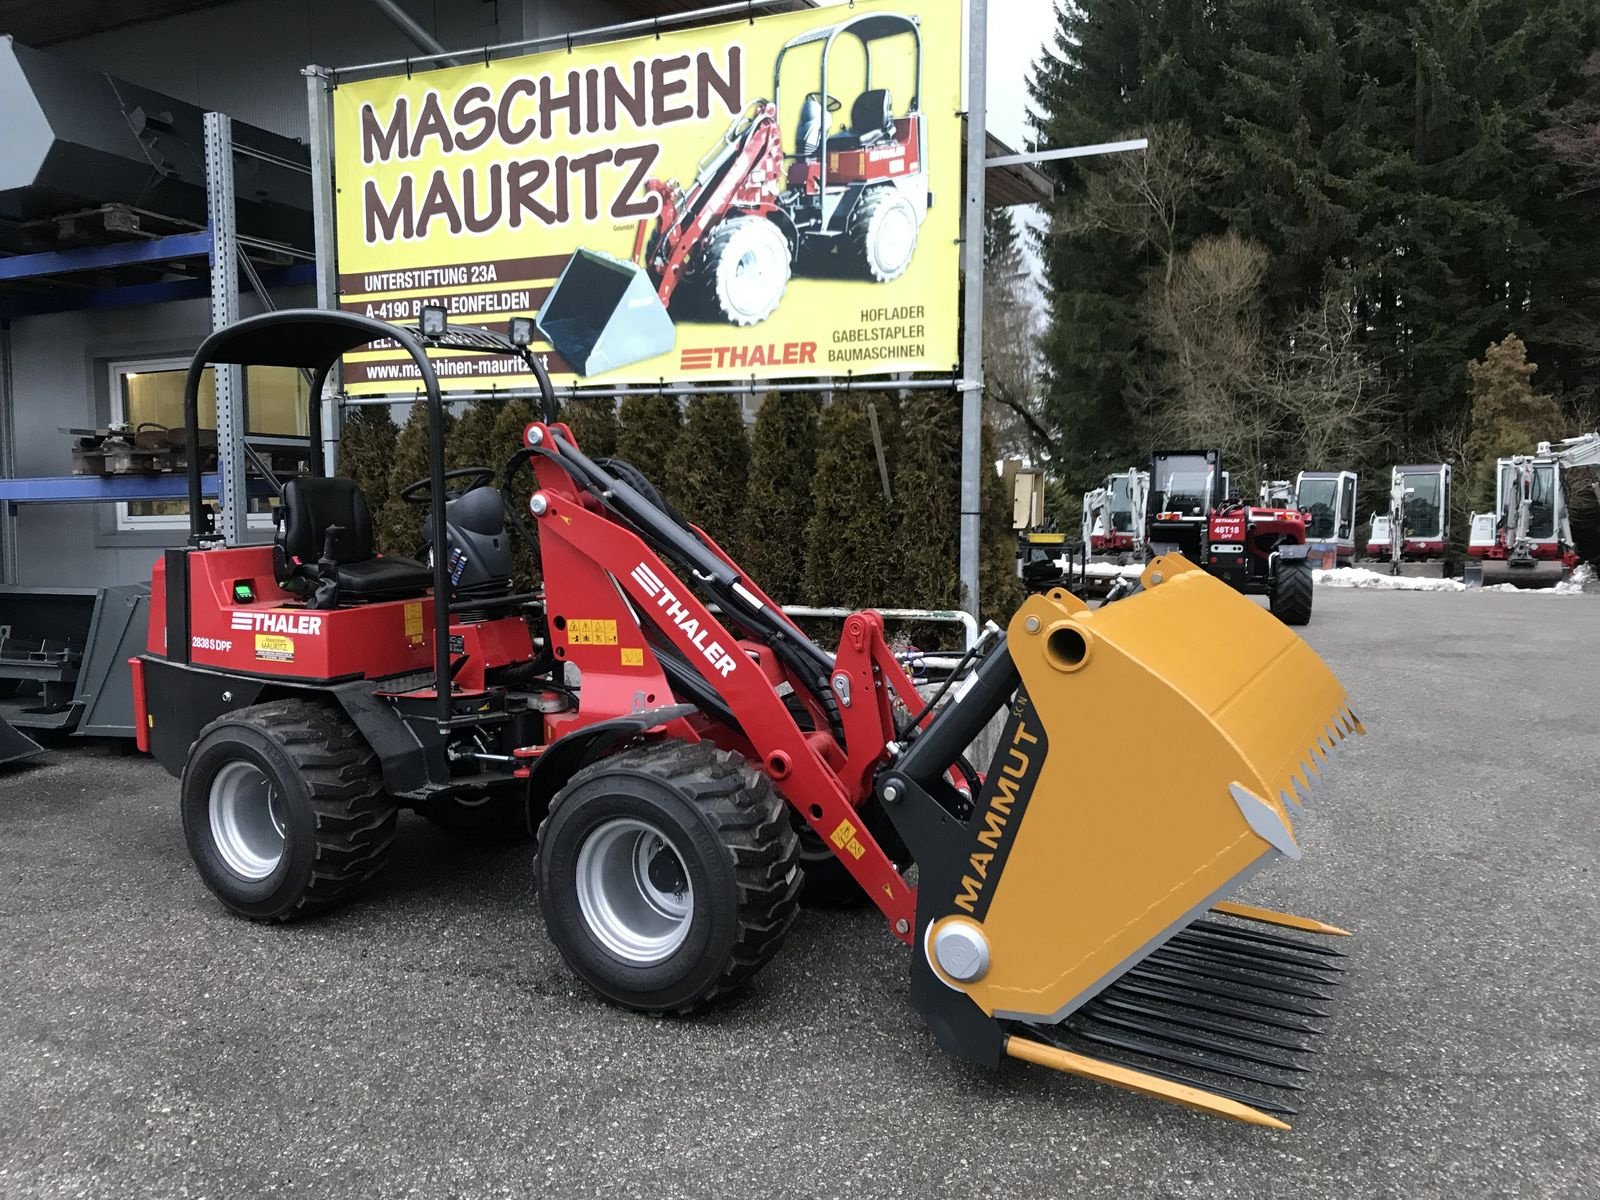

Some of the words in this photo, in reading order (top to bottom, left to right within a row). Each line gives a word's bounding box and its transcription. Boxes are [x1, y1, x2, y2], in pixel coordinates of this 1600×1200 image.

[362, 46, 741, 163] MASCHINEN
[364, 143, 660, 243] MAURITZ
[364, 268, 468, 292] UNTERSTIFTUNG
[471, 264, 497, 282] 23A
[366, 301, 409, 319] A-4190
[444, 291, 530, 314] LEONFELDEN
[860, 305, 925, 322] HOFLADER
[832, 324, 925, 343] GABELSTAPLER
[713, 341, 818, 369] THALER
[828, 344, 925, 362] BAUMASCHINEN
[366, 354, 549, 379] www.mahinen-mauritzt
[1214, 526, 1240, 534] 48T18
[253, 613, 322, 635] THALER
[657, 586, 737, 678] THALER
[192, 635, 210, 649] 2838
[210, 639, 215, 650] S
[215, 640, 232, 652] DPF
[954, 721, 1038, 914] MAMMUT
